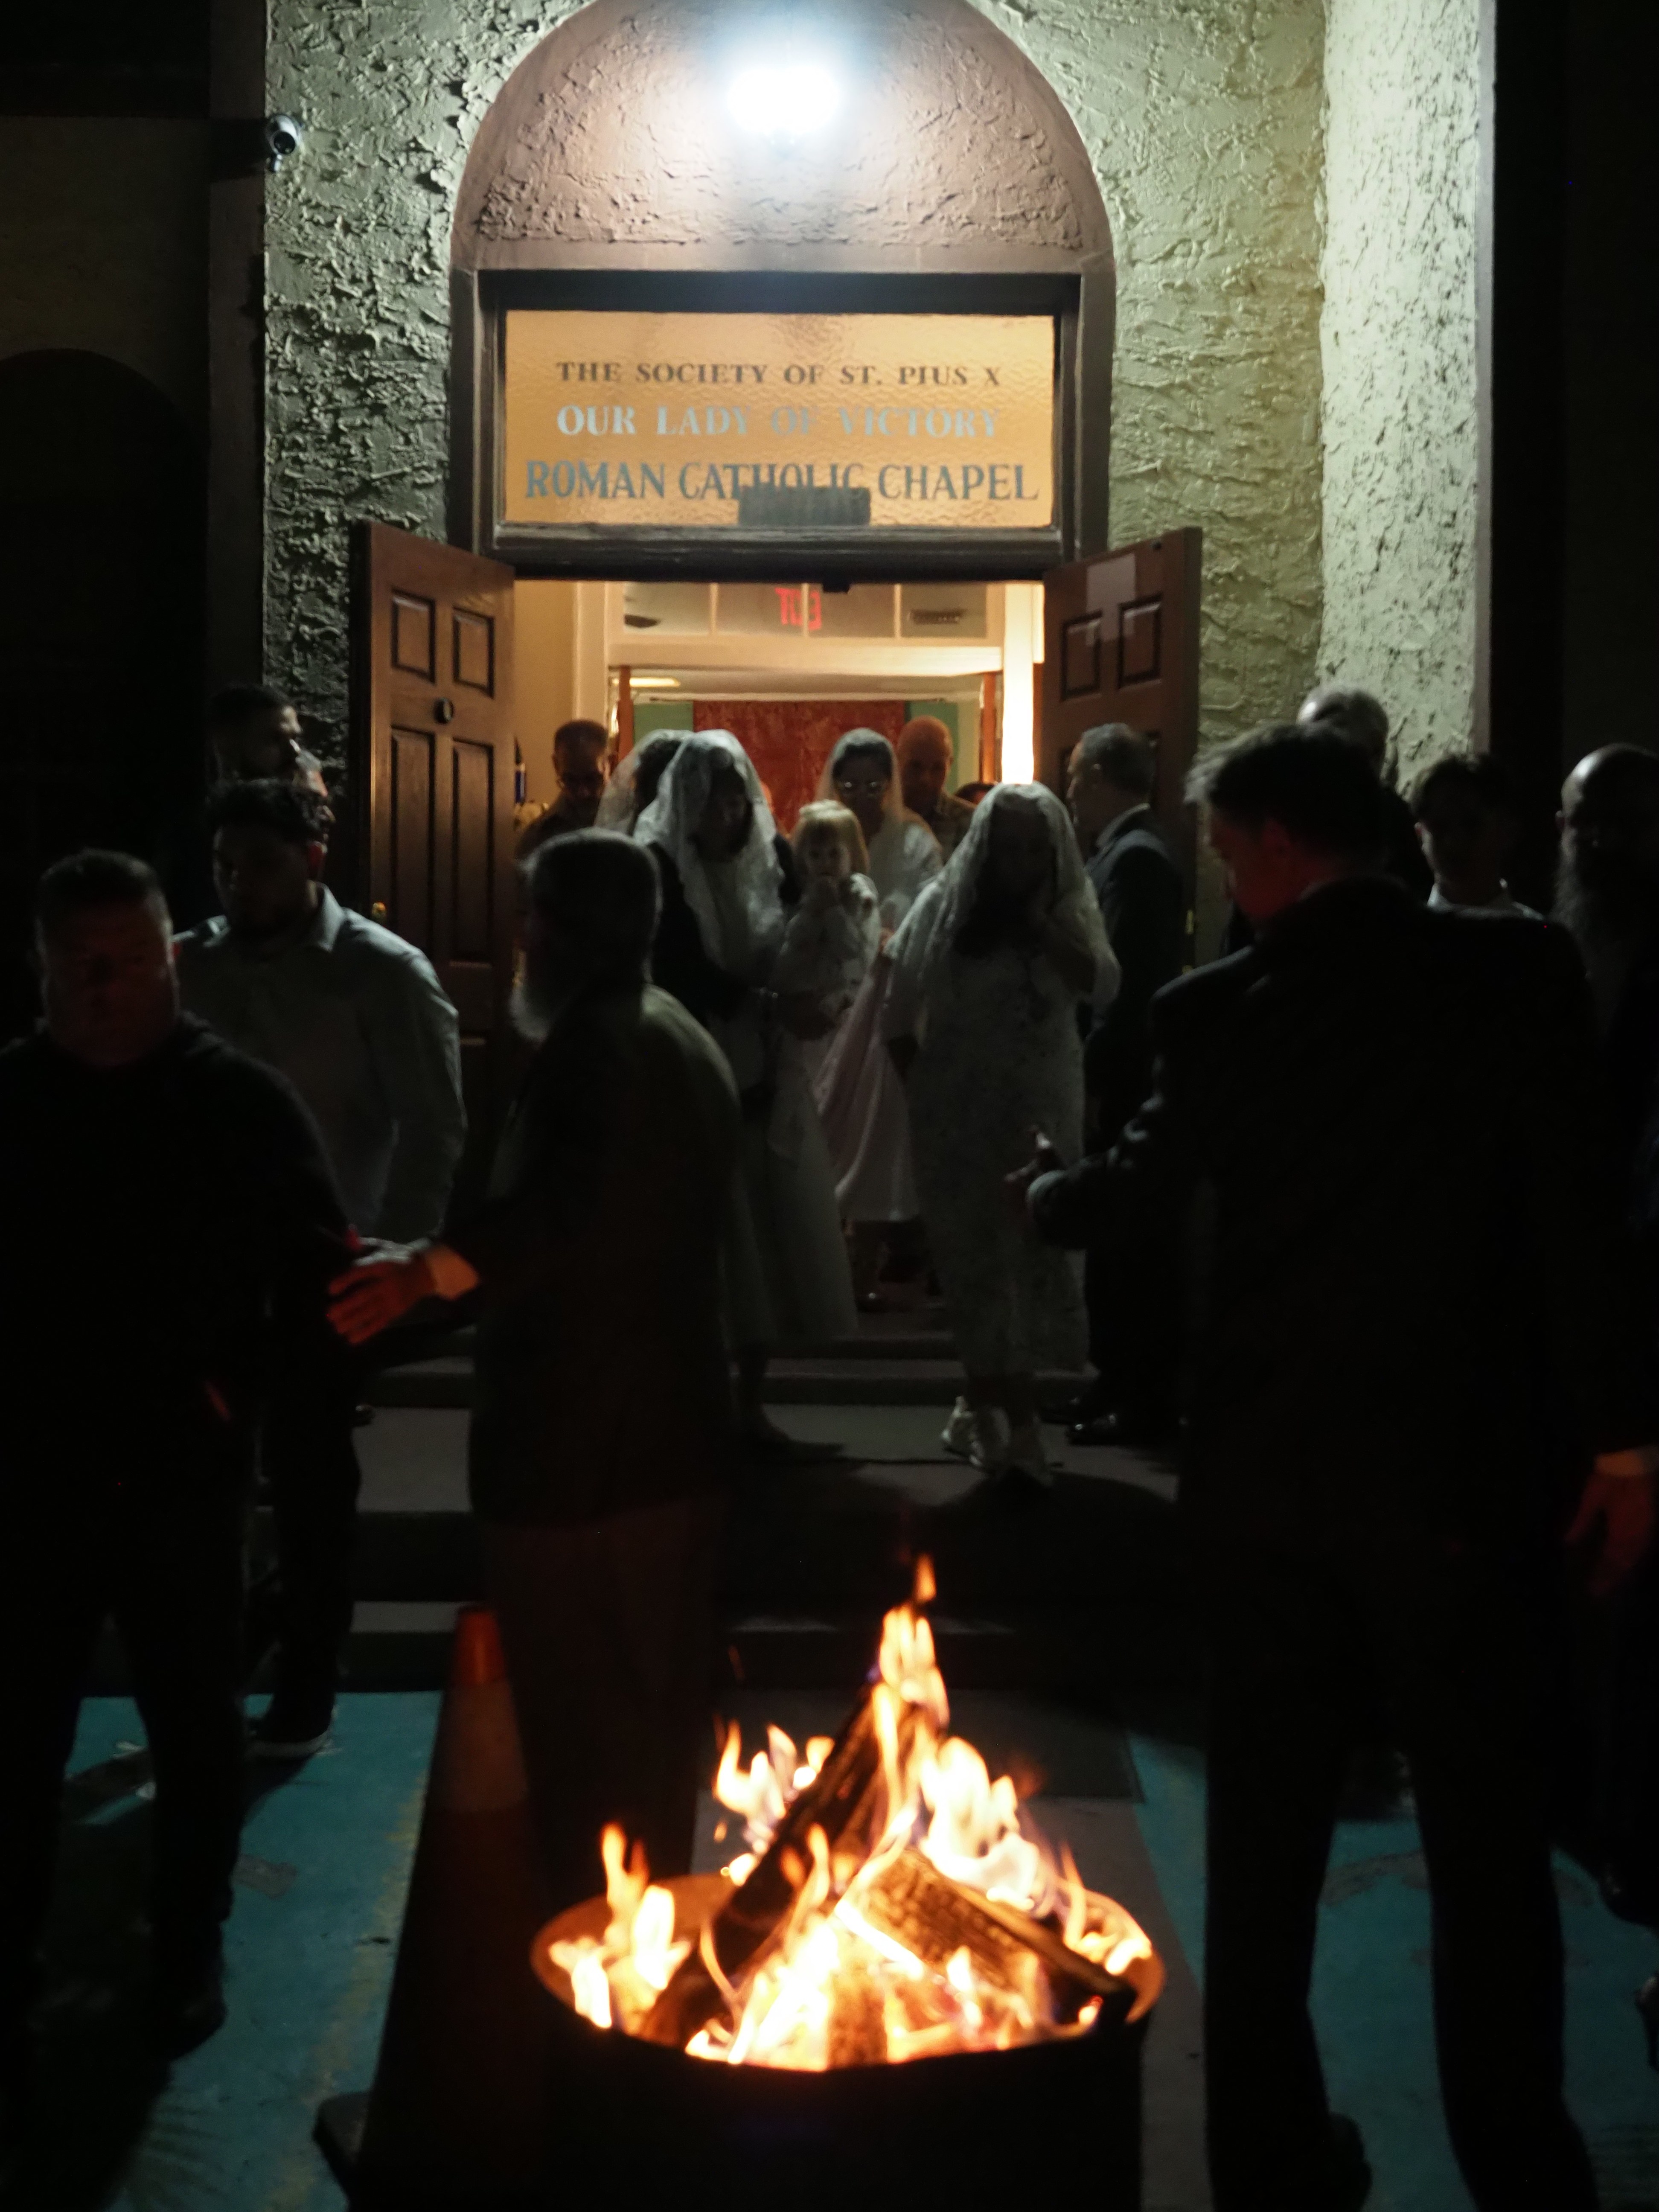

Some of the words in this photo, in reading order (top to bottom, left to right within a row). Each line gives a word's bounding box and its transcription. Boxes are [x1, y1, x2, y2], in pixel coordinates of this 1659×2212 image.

[556, 361, 620, 383] THE
[636, 362, 768, 384] SOCIETY
[783, 364, 824, 384] OF
[839, 364, 882, 385] ST.
[897, 365, 968, 385] PIUS
[984, 366, 1001, 386] X
[556, 404, 636, 436] OUR
[656, 405, 751, 436] LADY
[770, 405, 819, 437] OF
[838, 405, 1001, 438] VICTORY
[525, 460, 666, 499] ROMAN
[877, 463, 1040, 501] CHAPEL
